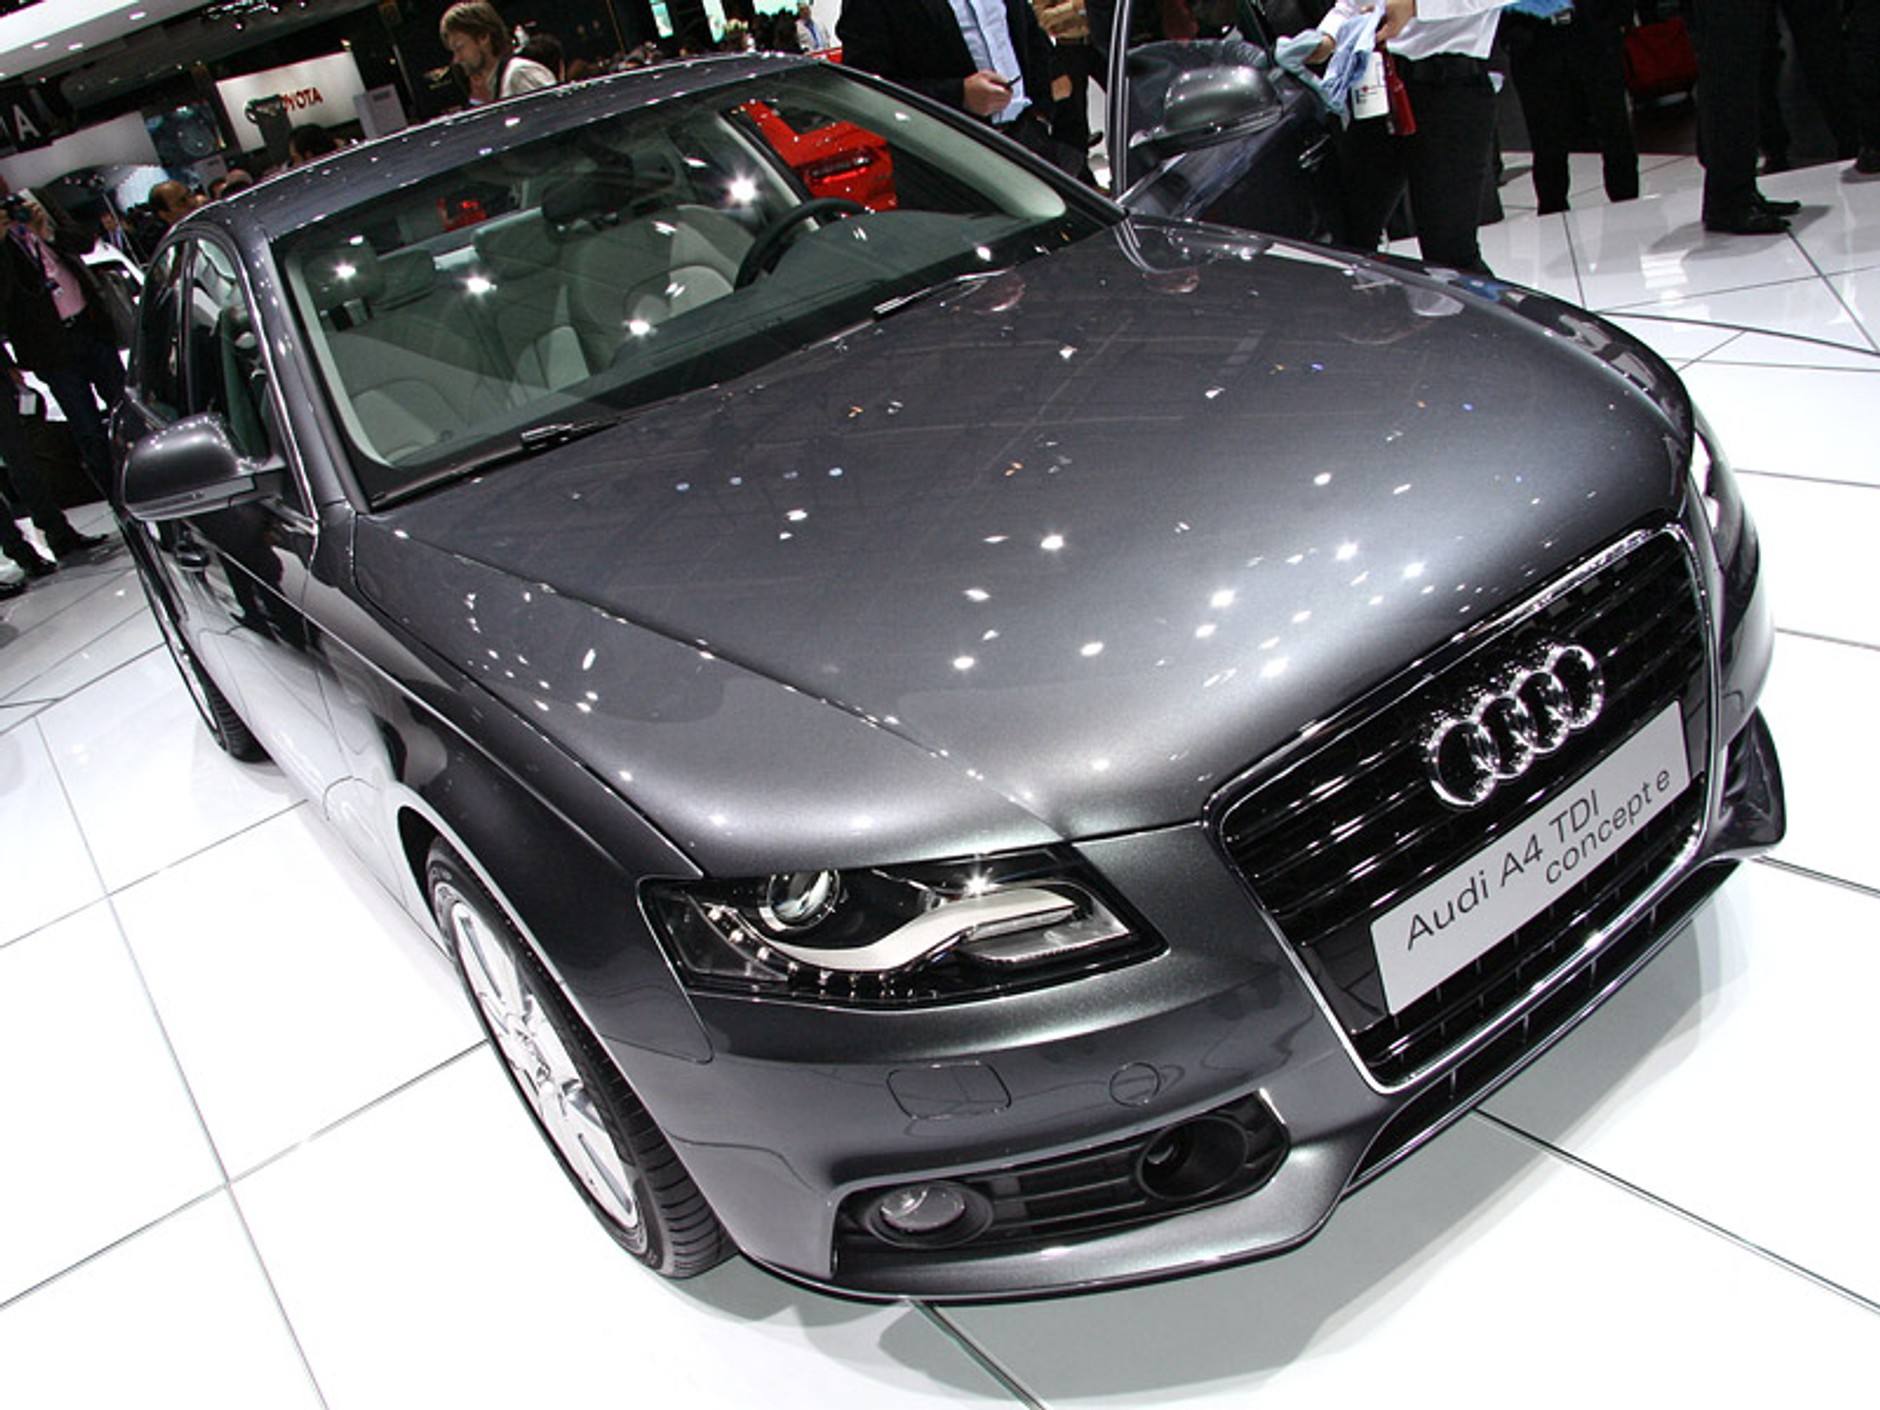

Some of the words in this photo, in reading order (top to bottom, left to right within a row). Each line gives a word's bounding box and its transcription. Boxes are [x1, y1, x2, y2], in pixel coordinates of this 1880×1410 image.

[1407, 869, 1489, 951] Audi
[1500, 833, 1544, 887] A4
[1548, 788, 1600, 844] TDI
[1545, 781, 1653, 885] concept
[1656, 769, 1671, 793] e
